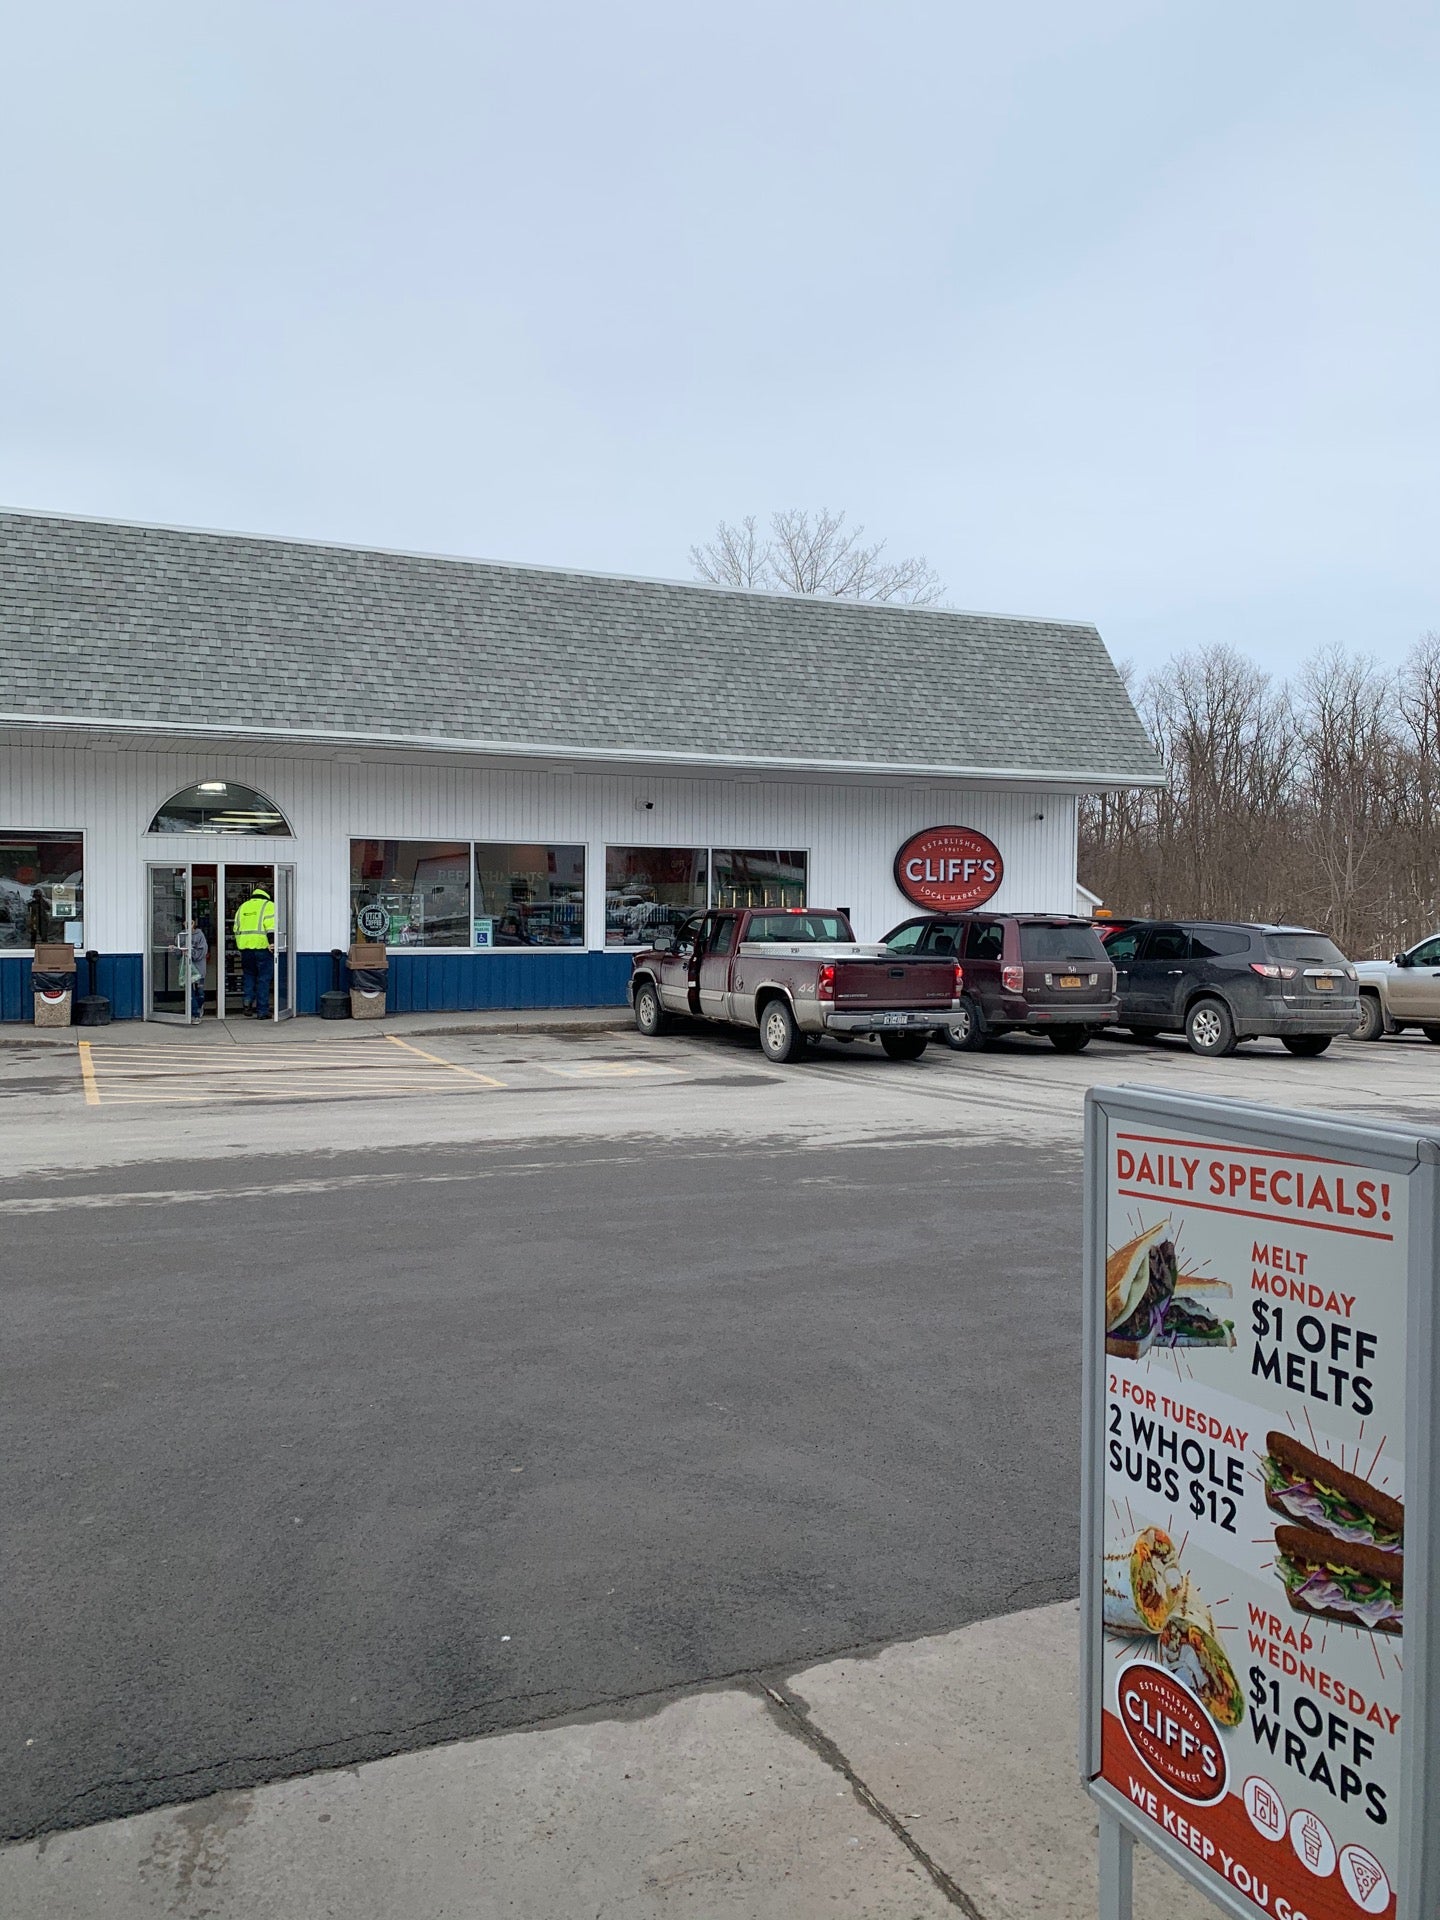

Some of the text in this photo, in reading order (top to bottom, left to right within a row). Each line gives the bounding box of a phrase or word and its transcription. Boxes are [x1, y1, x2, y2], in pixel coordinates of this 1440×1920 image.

[905, 858, 996, 882] CLIFF'S
[922, 838, 982, 852] ESTABLISHED
[920, 886, 982, 901] LOCAL MARKET
[1117, 1149, 1391, 1222] DAILY SPECIALS!
[1251, 1241, 1308, 1275] MELT
[1251, 1268, 1356, 1318] MONDAY
[1251, 1298, 1377, 1369] $1 OFF
[1109, 1374, 1249, 1451] 2 FOR TUESDAY
[1251, 1341, 1373, 1416] MELTS
[1109, 1403, 1244, 1496] 2 WHOLE
[1109, 1439, 1237, 1534] SUBS $12
[1247, 1602, 1314, 1655] WRAP
[1139, 1681, 1200, 1729] ESTABLISHED
[1247, 1629, 1401, 1735] WEDNESDAY
[1249, 1665, 1375, 1767] $1 OFF
[1125, 1690, 1217, 1778] CLIFF'S
[1139, 1731, 1201, 1783] LOCAL MARKET
[1249, 1706, 1388, 1825] WRAPS
[1128, 1776, 1158, 1820] WE
[1163, 1804, 1215, 1861] KEEP
[1219, 1849, 1269, 1907] YOU
